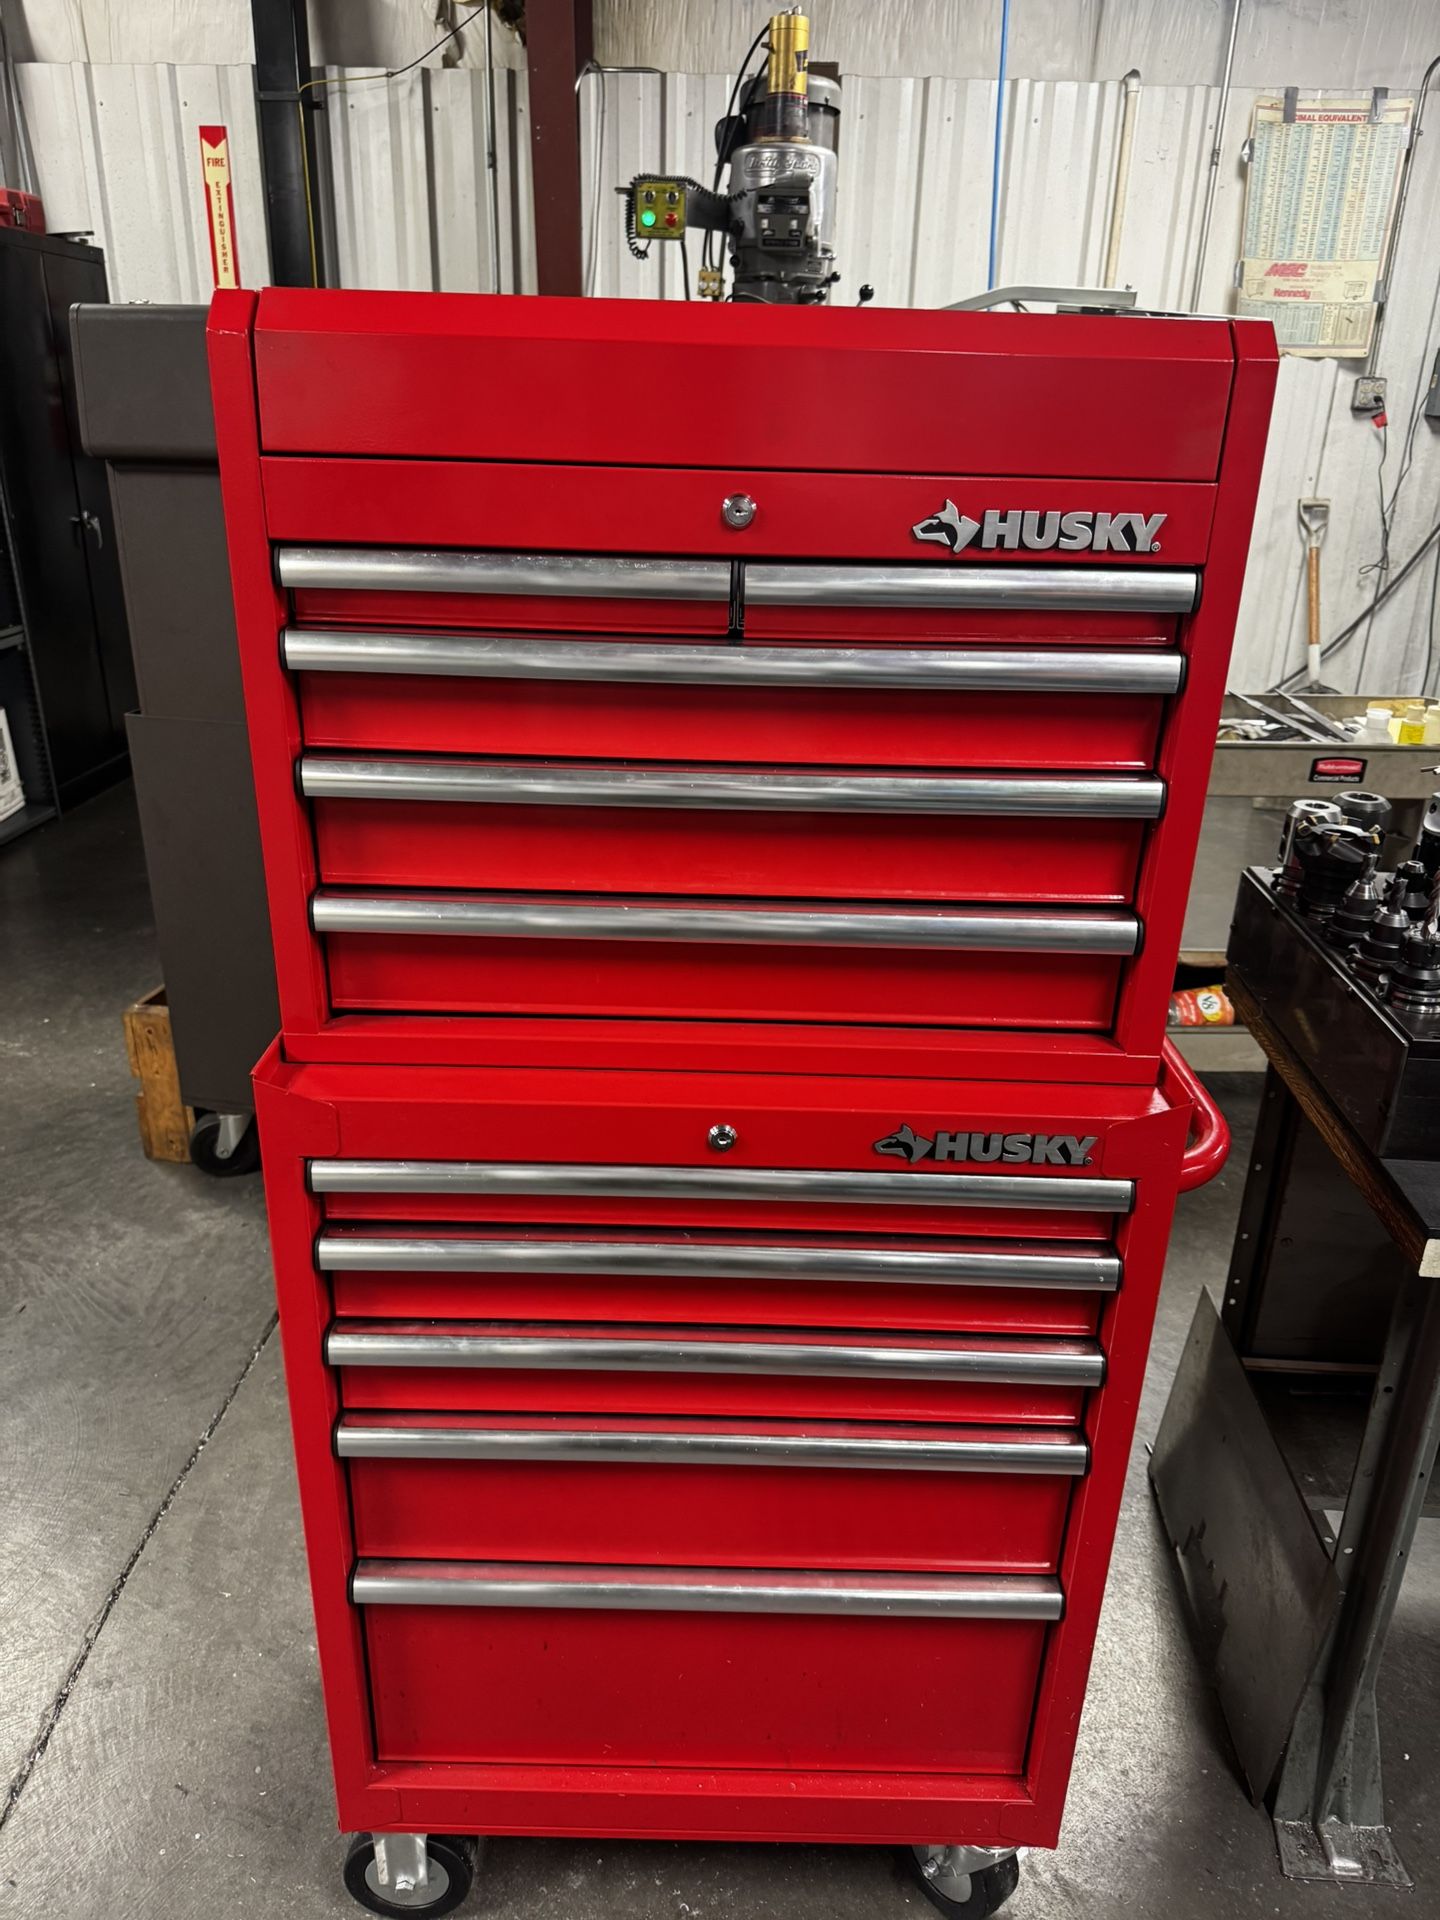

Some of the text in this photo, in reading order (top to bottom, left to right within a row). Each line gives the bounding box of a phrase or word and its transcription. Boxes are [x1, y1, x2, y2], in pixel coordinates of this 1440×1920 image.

[1295, 114, 1317, 122] CIMAL
[206, 157, 226, 168] FIRE
[215, 181, 229, 273] EXTINGUISHER
[1273, 288, 1311, 300] Kennedy
[981, 509, 1168, 553] HUSKY
[1202, 995, 1219, 1010] V8
[934, 1131, 1099, 1166] HUSKY
